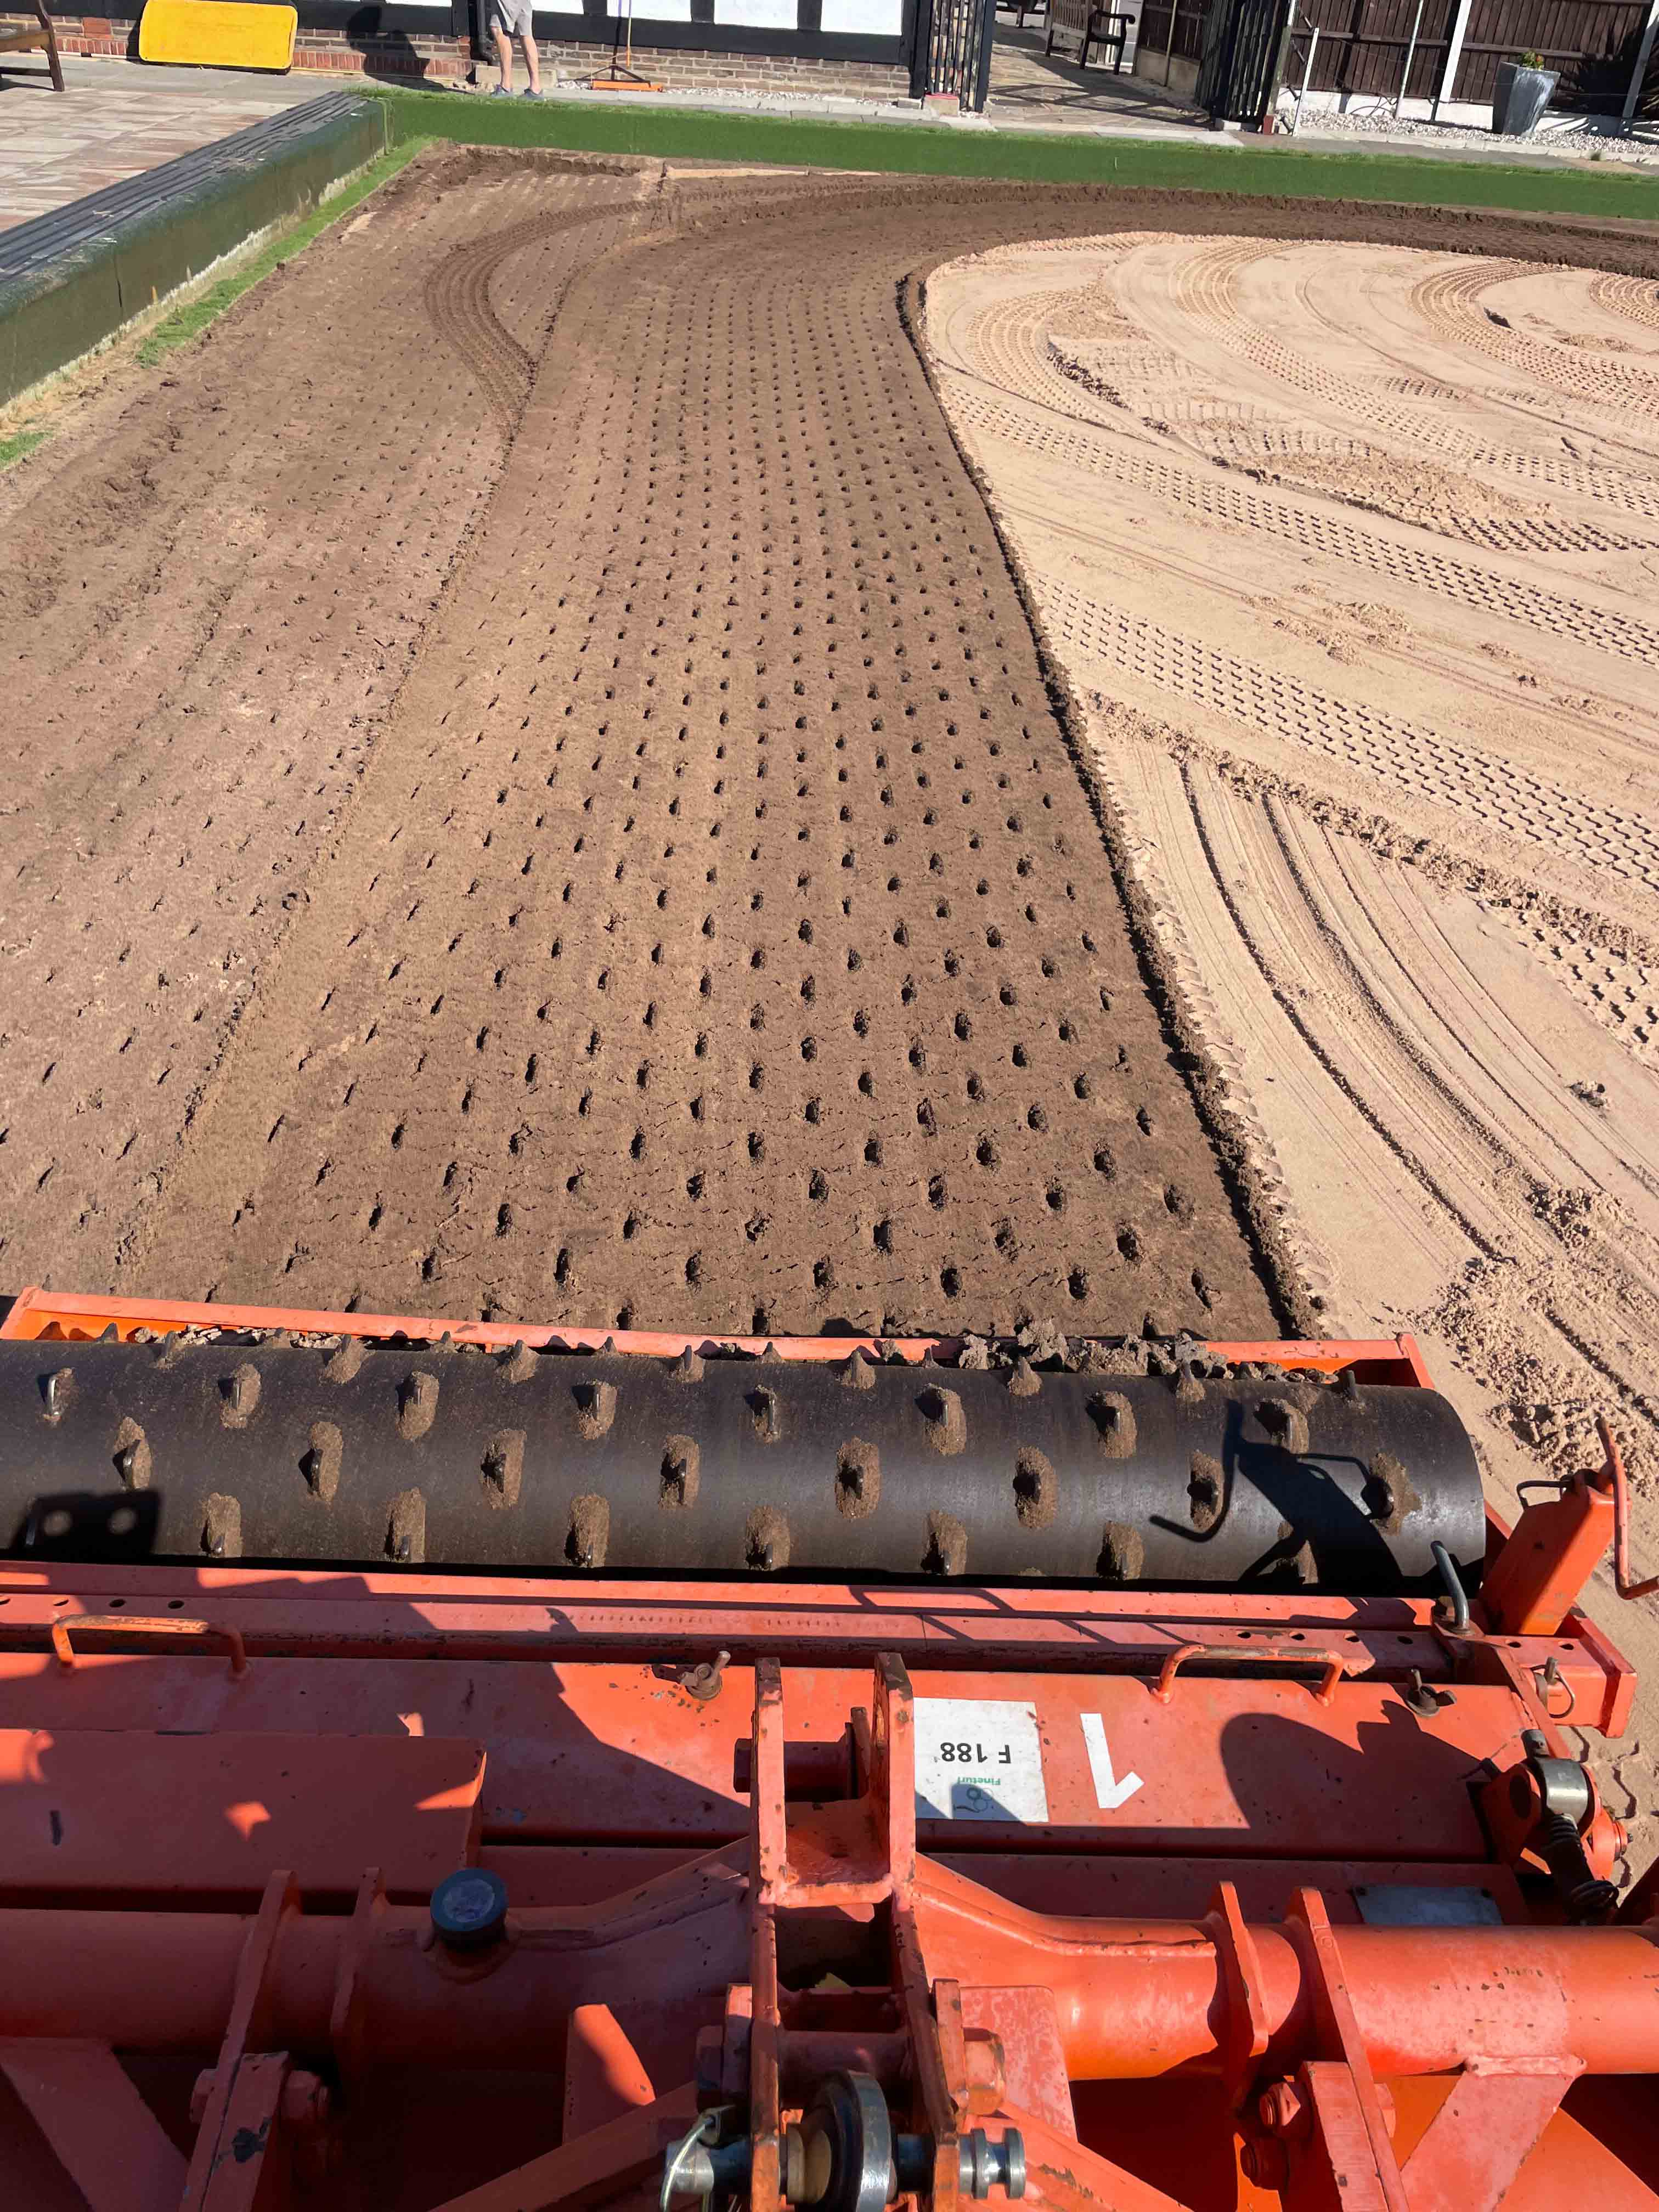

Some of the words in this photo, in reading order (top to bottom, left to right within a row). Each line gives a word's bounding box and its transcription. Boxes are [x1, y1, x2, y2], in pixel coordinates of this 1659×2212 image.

[940, 1742, 988, 1763] 188
[998, 1745, 1011, 1764] F
[1080, 1713, 1145, 1809] 1
